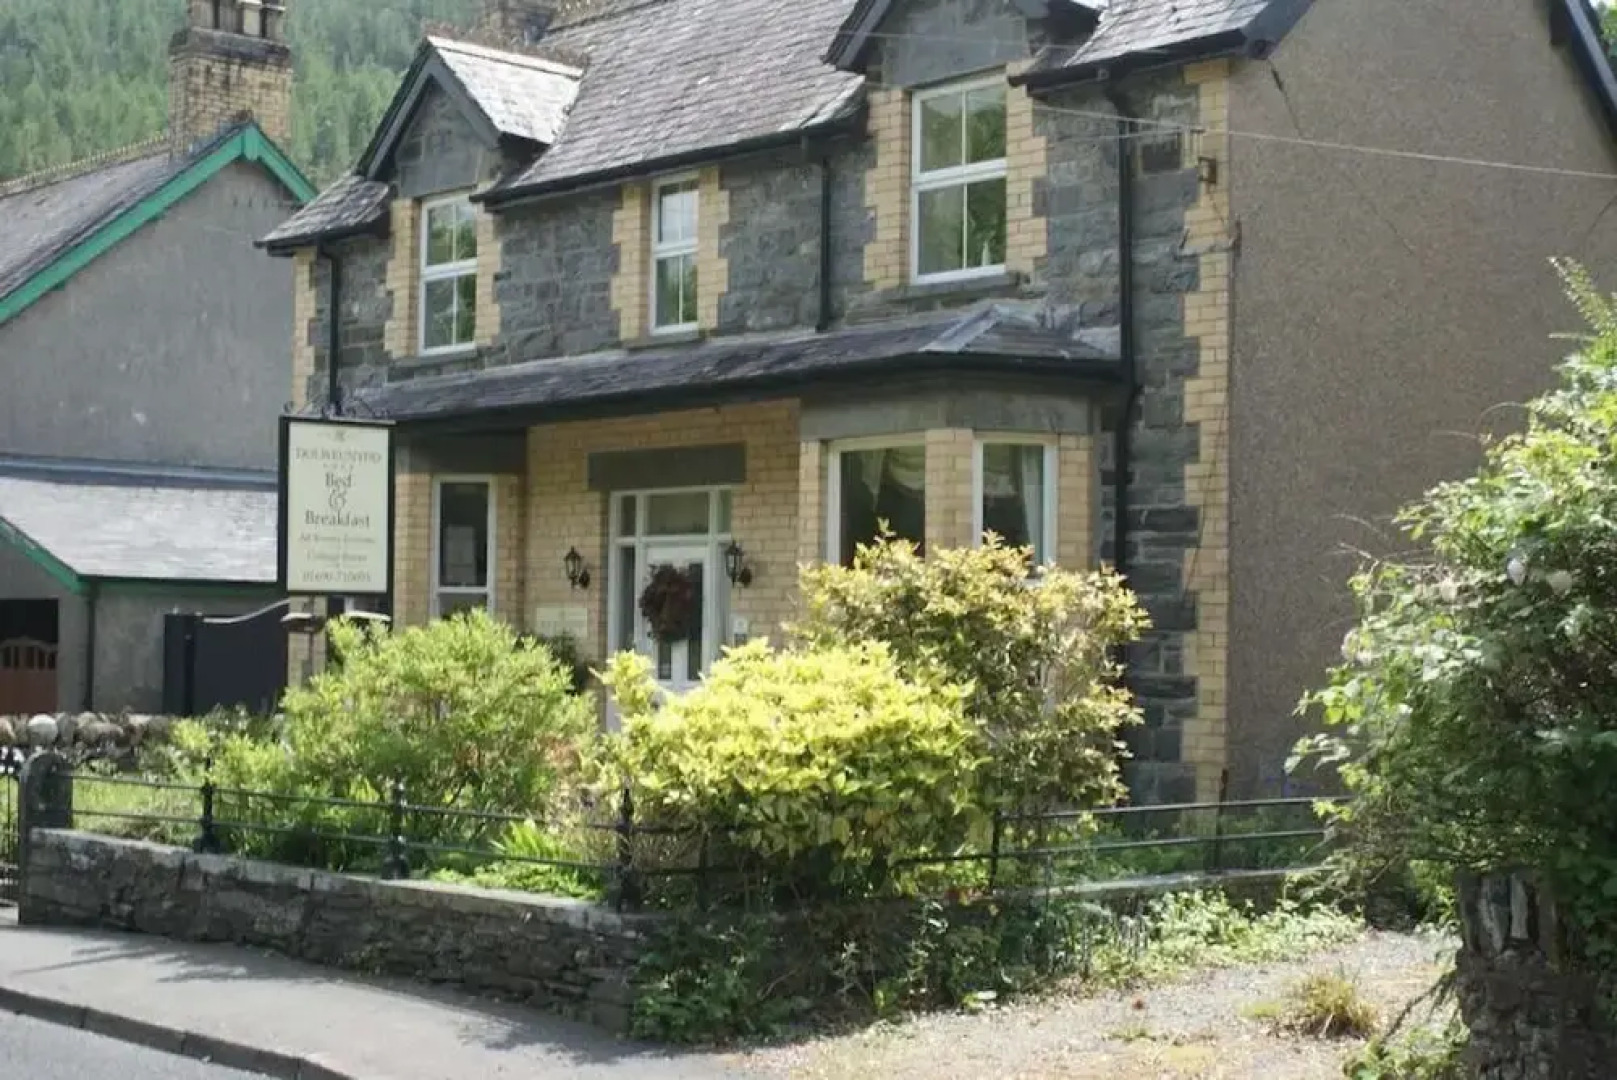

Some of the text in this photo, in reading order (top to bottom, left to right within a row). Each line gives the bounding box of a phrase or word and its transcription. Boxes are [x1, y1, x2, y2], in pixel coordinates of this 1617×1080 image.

[325, 472, 352, 488] Bed
[328, 488, 347, 510] &
[305, 510, 370, 527] Breakfast
